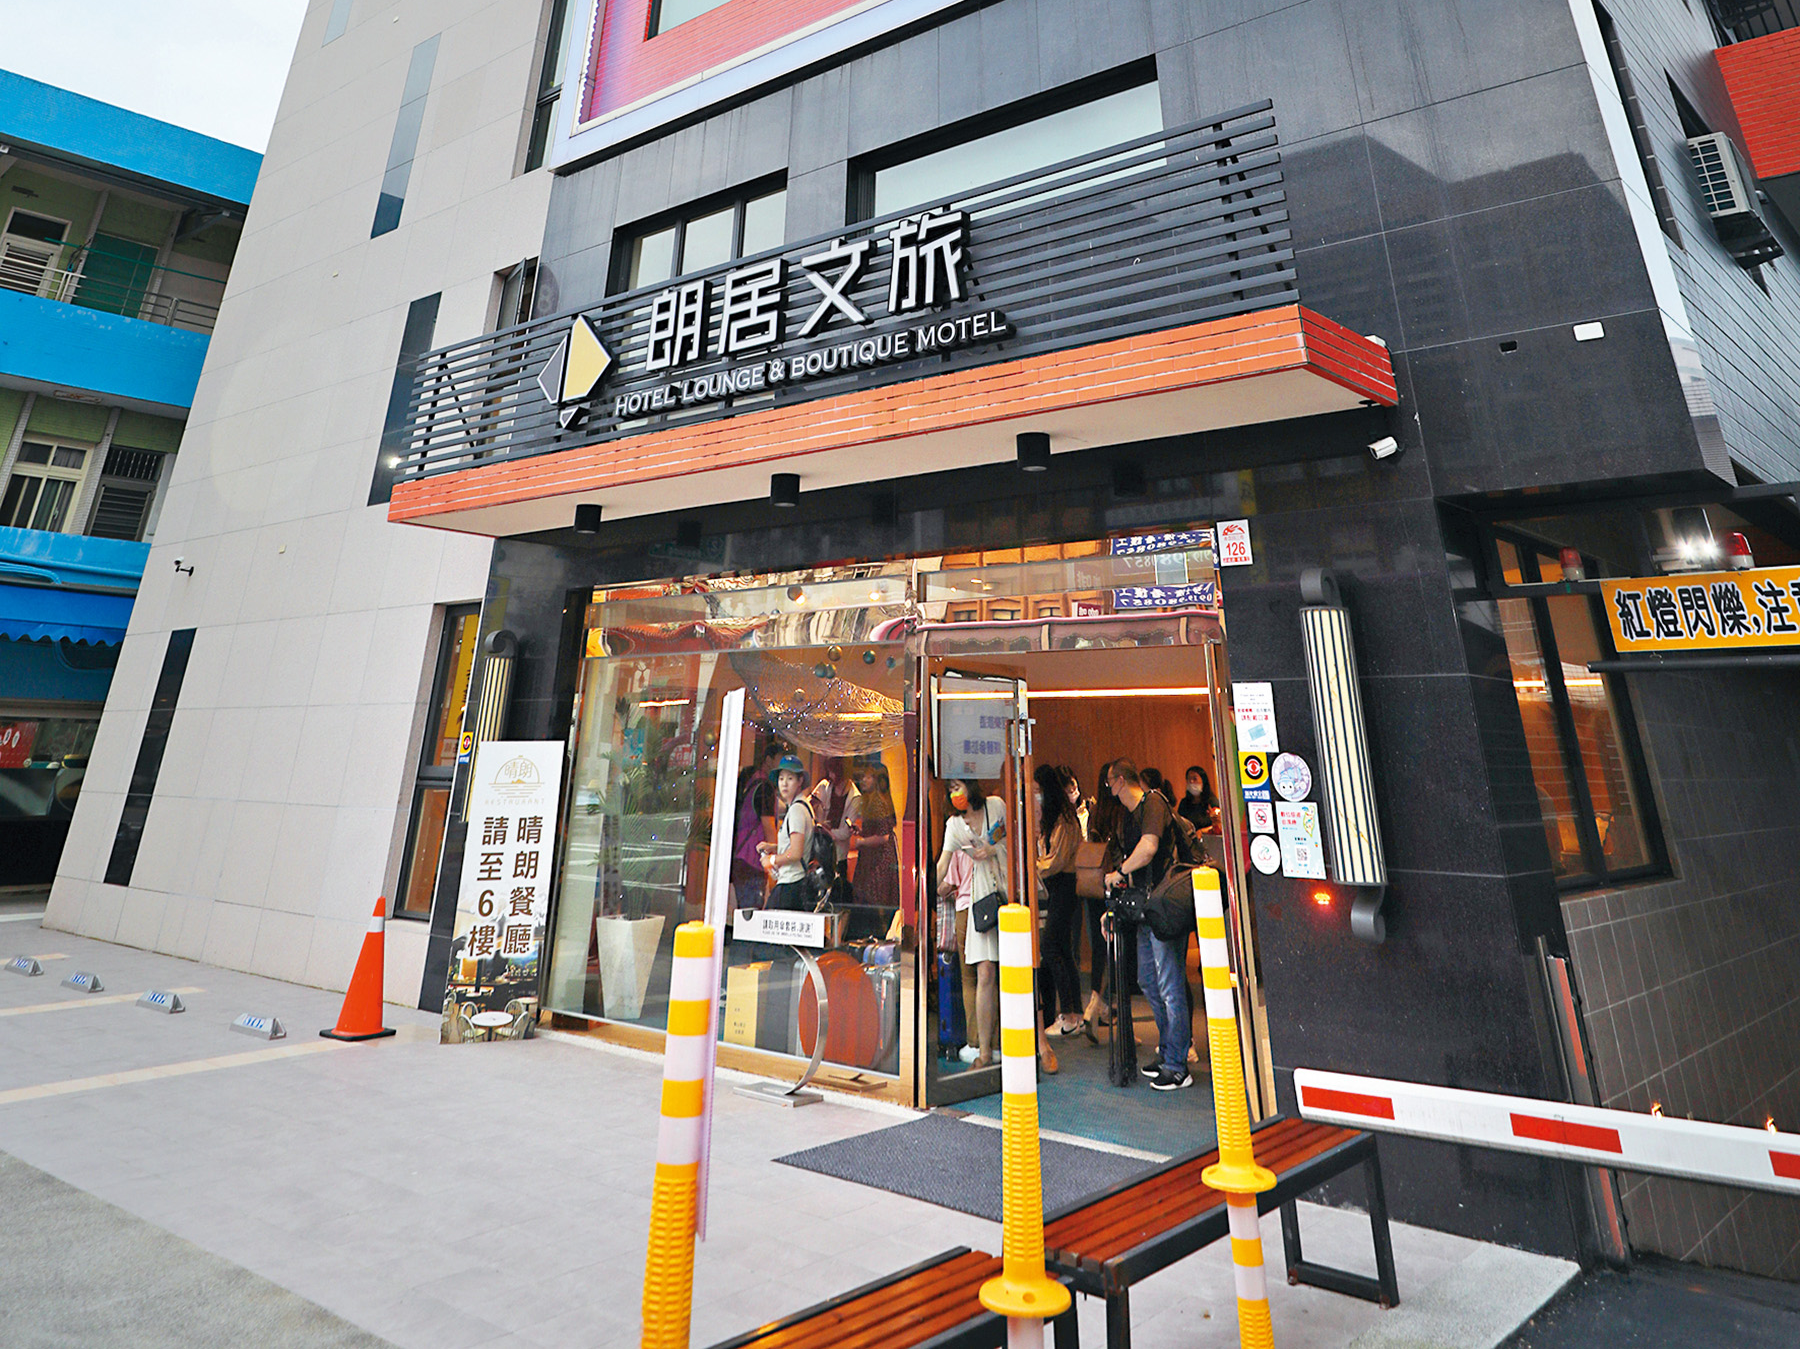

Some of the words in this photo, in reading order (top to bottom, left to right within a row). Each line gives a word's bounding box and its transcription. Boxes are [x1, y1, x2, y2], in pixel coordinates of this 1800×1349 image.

[645, 211, 969, 372] 朗居文旅
[615, 383, 675, 416] HOTEL
[681, 368, 765, 402] LOUNGE
[768, 361, 785, 384] &
[791, 333, 909, 380] BOUTIQUE
[916, 311, 1007, 349] MOTEL
[1226, 541, 1246, 556] 126
[504, 761, 533, 779] 晴朗
[467, 816, 509, 957] 請至6樓
[503, 815, 543, 954] 晴朗餐廳
